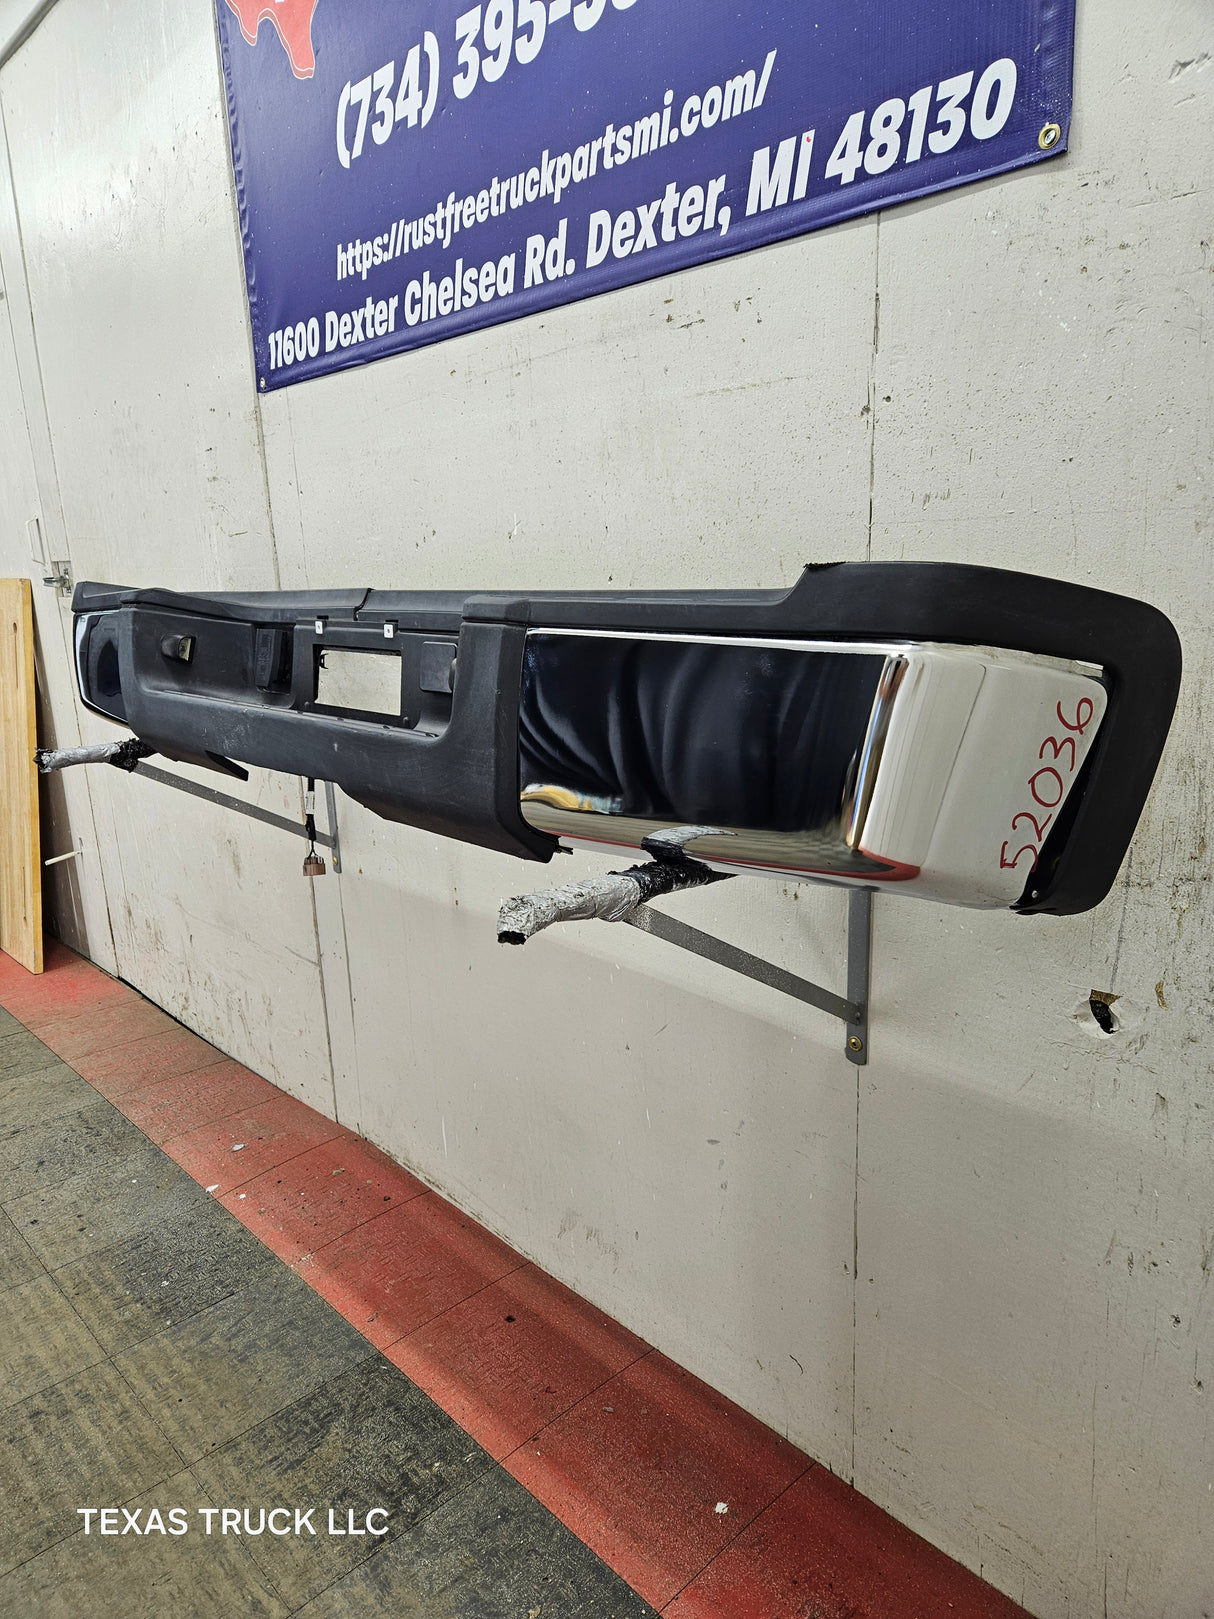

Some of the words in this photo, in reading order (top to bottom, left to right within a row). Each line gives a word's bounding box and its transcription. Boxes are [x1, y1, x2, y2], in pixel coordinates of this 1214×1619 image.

[337, 31, 439, 169] (734)
[452, 0, 638, 100] 395-
[337, 50, 778, 280] https://rustfreetruckpartsmi.com/
[268, 317, 320, 370] 11600
[325, 294, 399, 353] Dexter
[404, 248, 516, 326] Chelsea
[524, 218, 576, 289] Rd.
[586, 175, 731, 269] Dexter,
[746, 129, 816, 217] MI
[824, 58, 1018, 185] 48130
[1000, 697, 1094, 873] 52036
